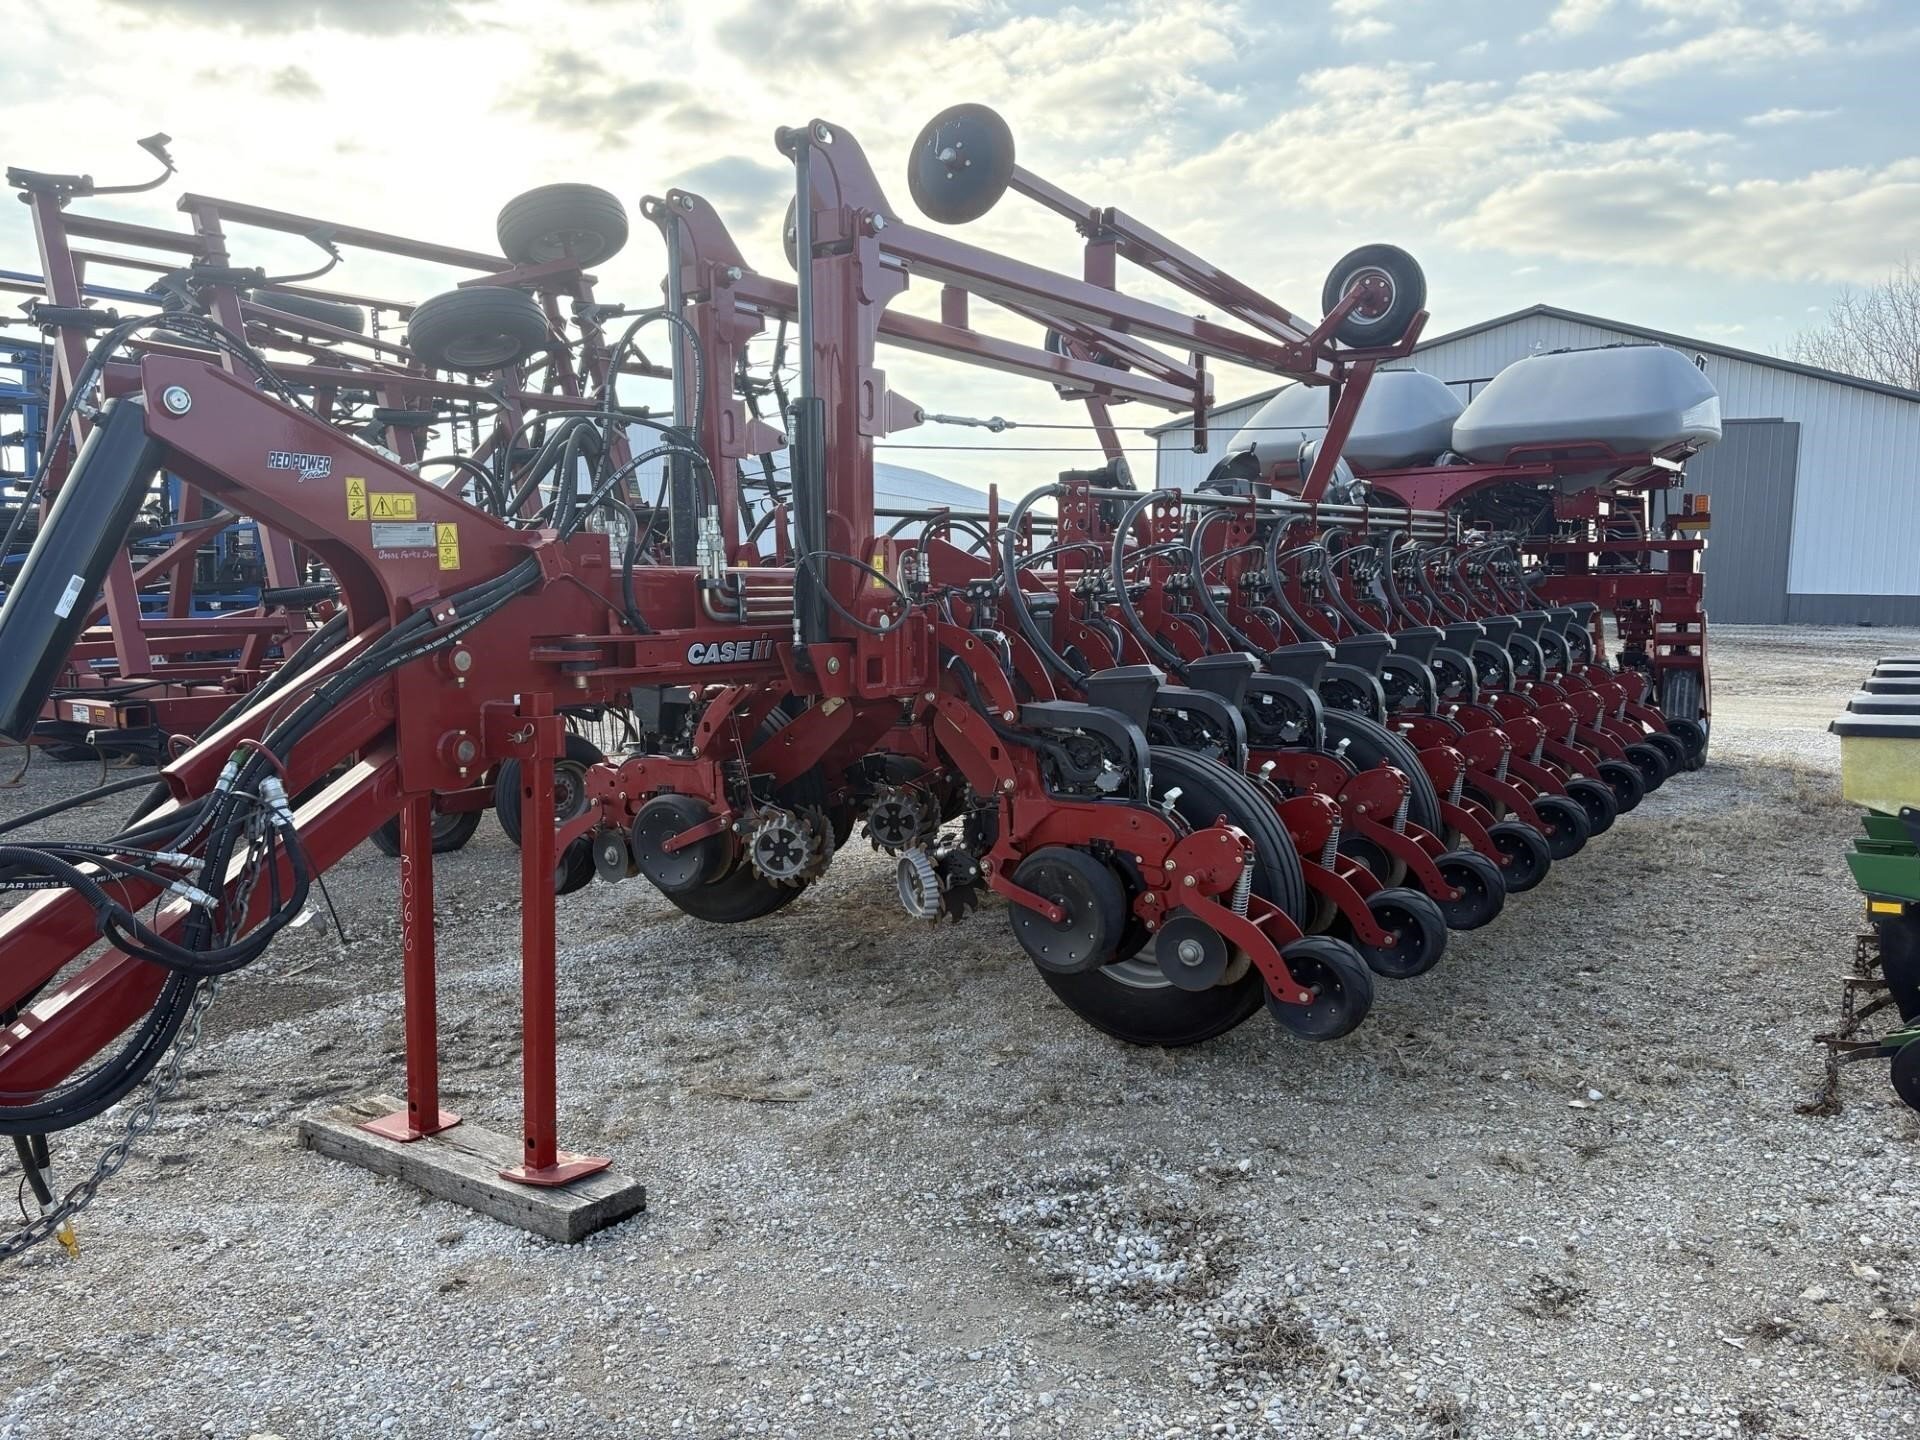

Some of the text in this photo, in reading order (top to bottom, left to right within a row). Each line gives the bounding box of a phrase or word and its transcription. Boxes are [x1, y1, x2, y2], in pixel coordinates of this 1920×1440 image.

[268, 451, 331, 471] RED POWER
[298, 469, 330, 483] Team
[687, 641, 751, 664] CASE
[401, 807, 413, 952] 113066
